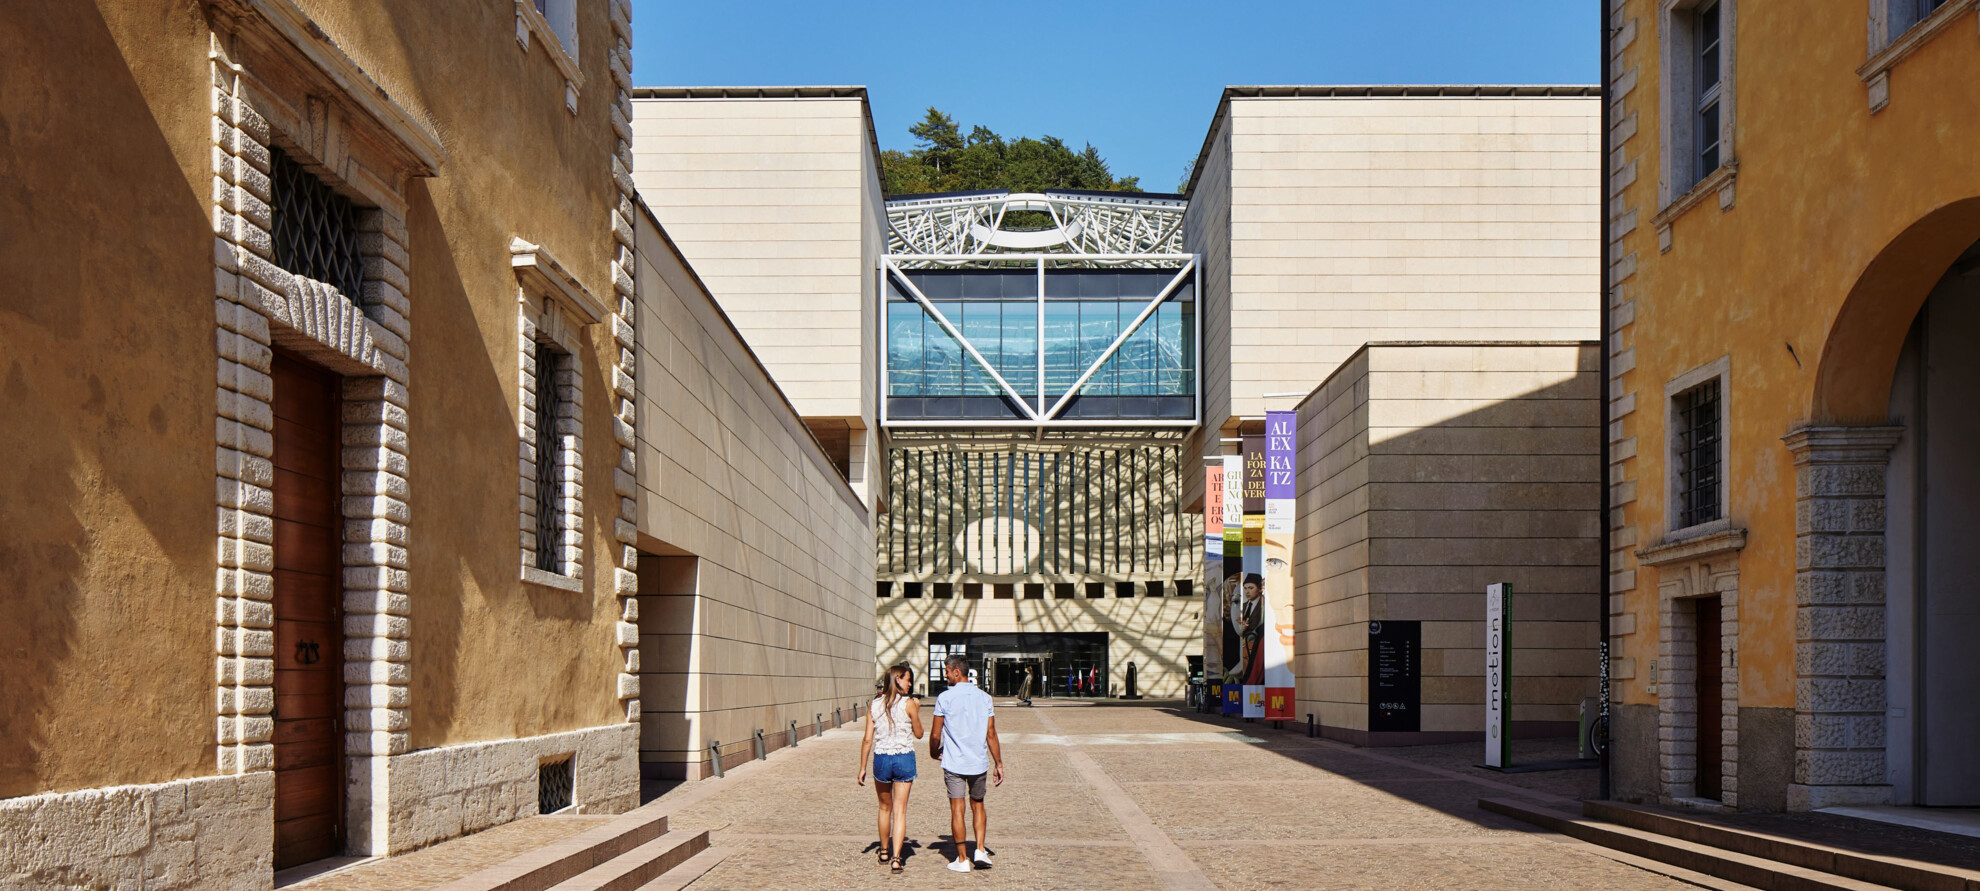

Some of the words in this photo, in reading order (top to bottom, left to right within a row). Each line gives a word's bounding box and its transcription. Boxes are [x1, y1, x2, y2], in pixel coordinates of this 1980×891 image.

[1271, 421, 1292, 435] AL
[1270, 437, 1291, 451] EX
[1251, 452, 1263, 460] LA
[1270, 456, 1291, 470] KA
[1247, 460, 1266, 469] FOR
[1250, 469, 1263, 477] ZA
[1270, 471, 1291, 485] TZ
[1215, 494, 1222, 503] E
[1489, 618, 1499, 739] e.motion
